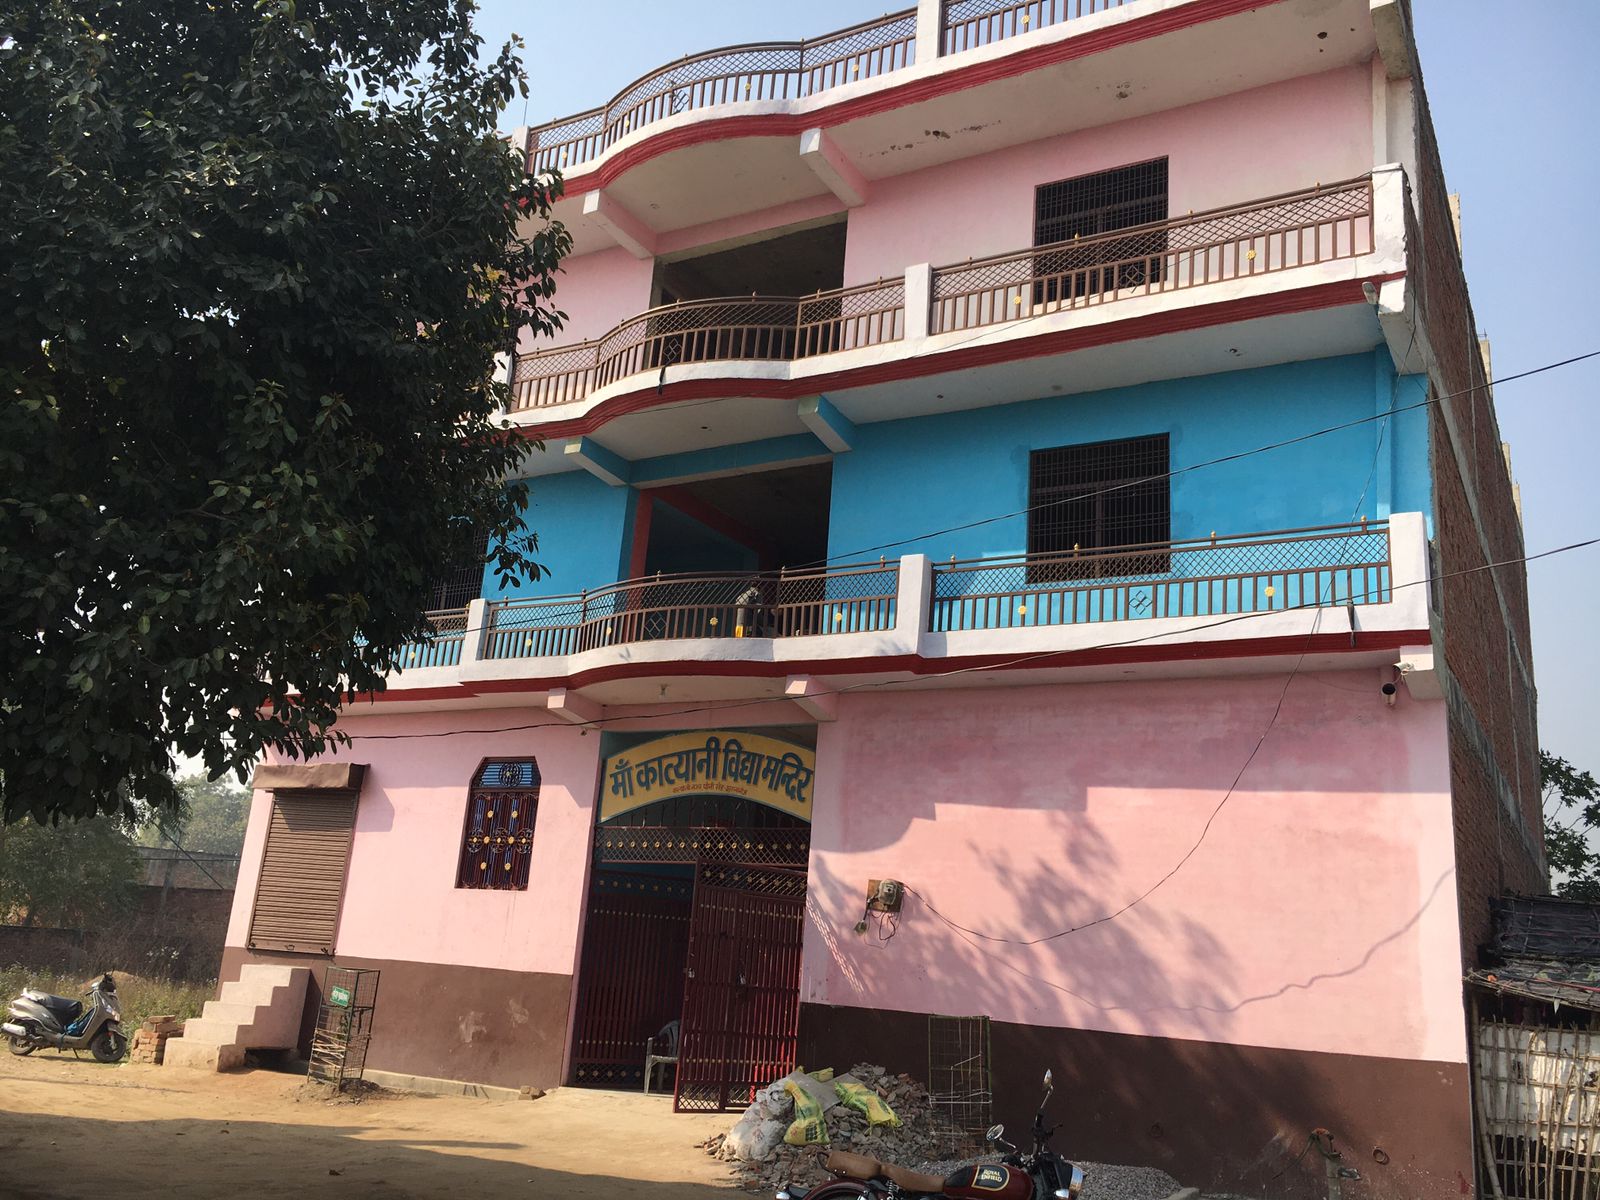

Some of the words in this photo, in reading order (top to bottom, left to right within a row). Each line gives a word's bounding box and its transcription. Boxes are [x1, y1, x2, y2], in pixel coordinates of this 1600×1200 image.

[723, 739, 765, 785] विद्या
[762, 752, 814, 802] मन्दिर
[981, 1174, 1002, 1182] ENFIELD
